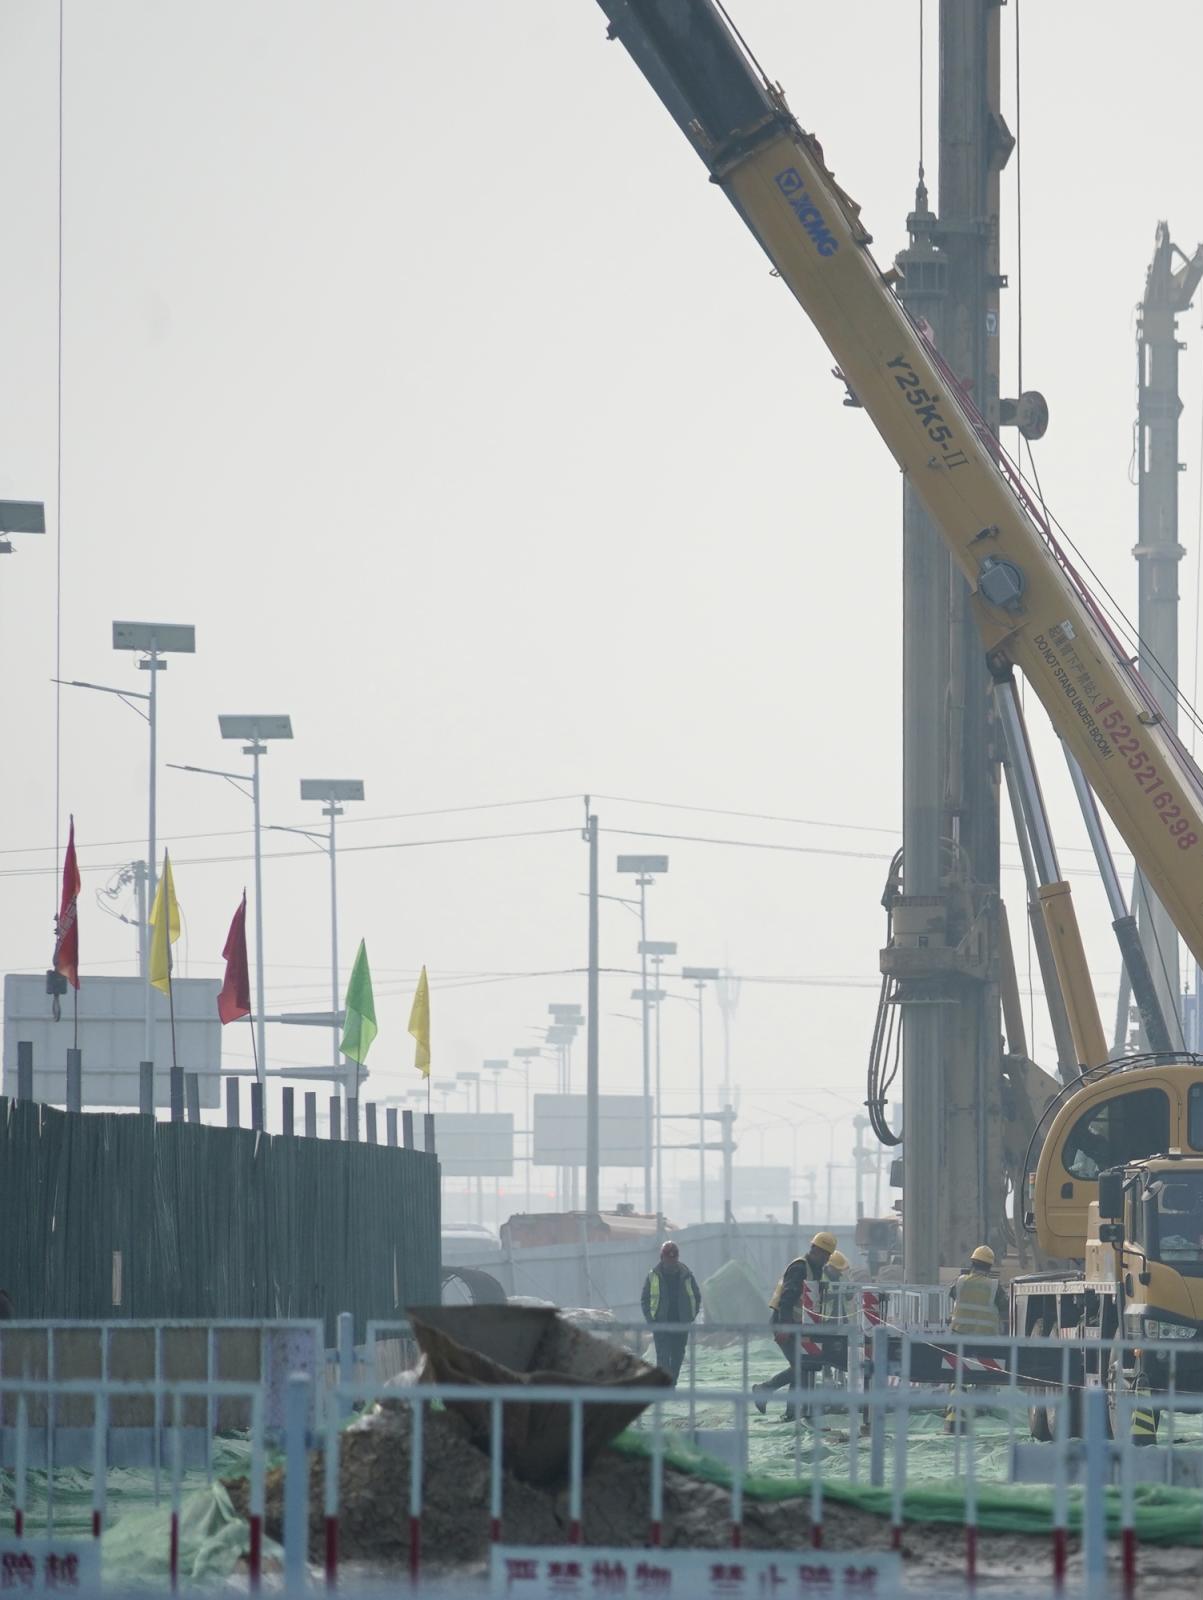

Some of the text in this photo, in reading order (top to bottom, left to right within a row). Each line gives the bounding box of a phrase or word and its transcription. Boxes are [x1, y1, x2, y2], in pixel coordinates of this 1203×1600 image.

[789, 189, 839, 257] XCMG
[1033, 634, 1047, 652] DO
[1042, 648, 1060, 671] NOT
[1054, 668, 1077, 700] STAND
[1071, 696, 1095, 732] UNDER
[1094, 696, 1198, 850] 15225216298
